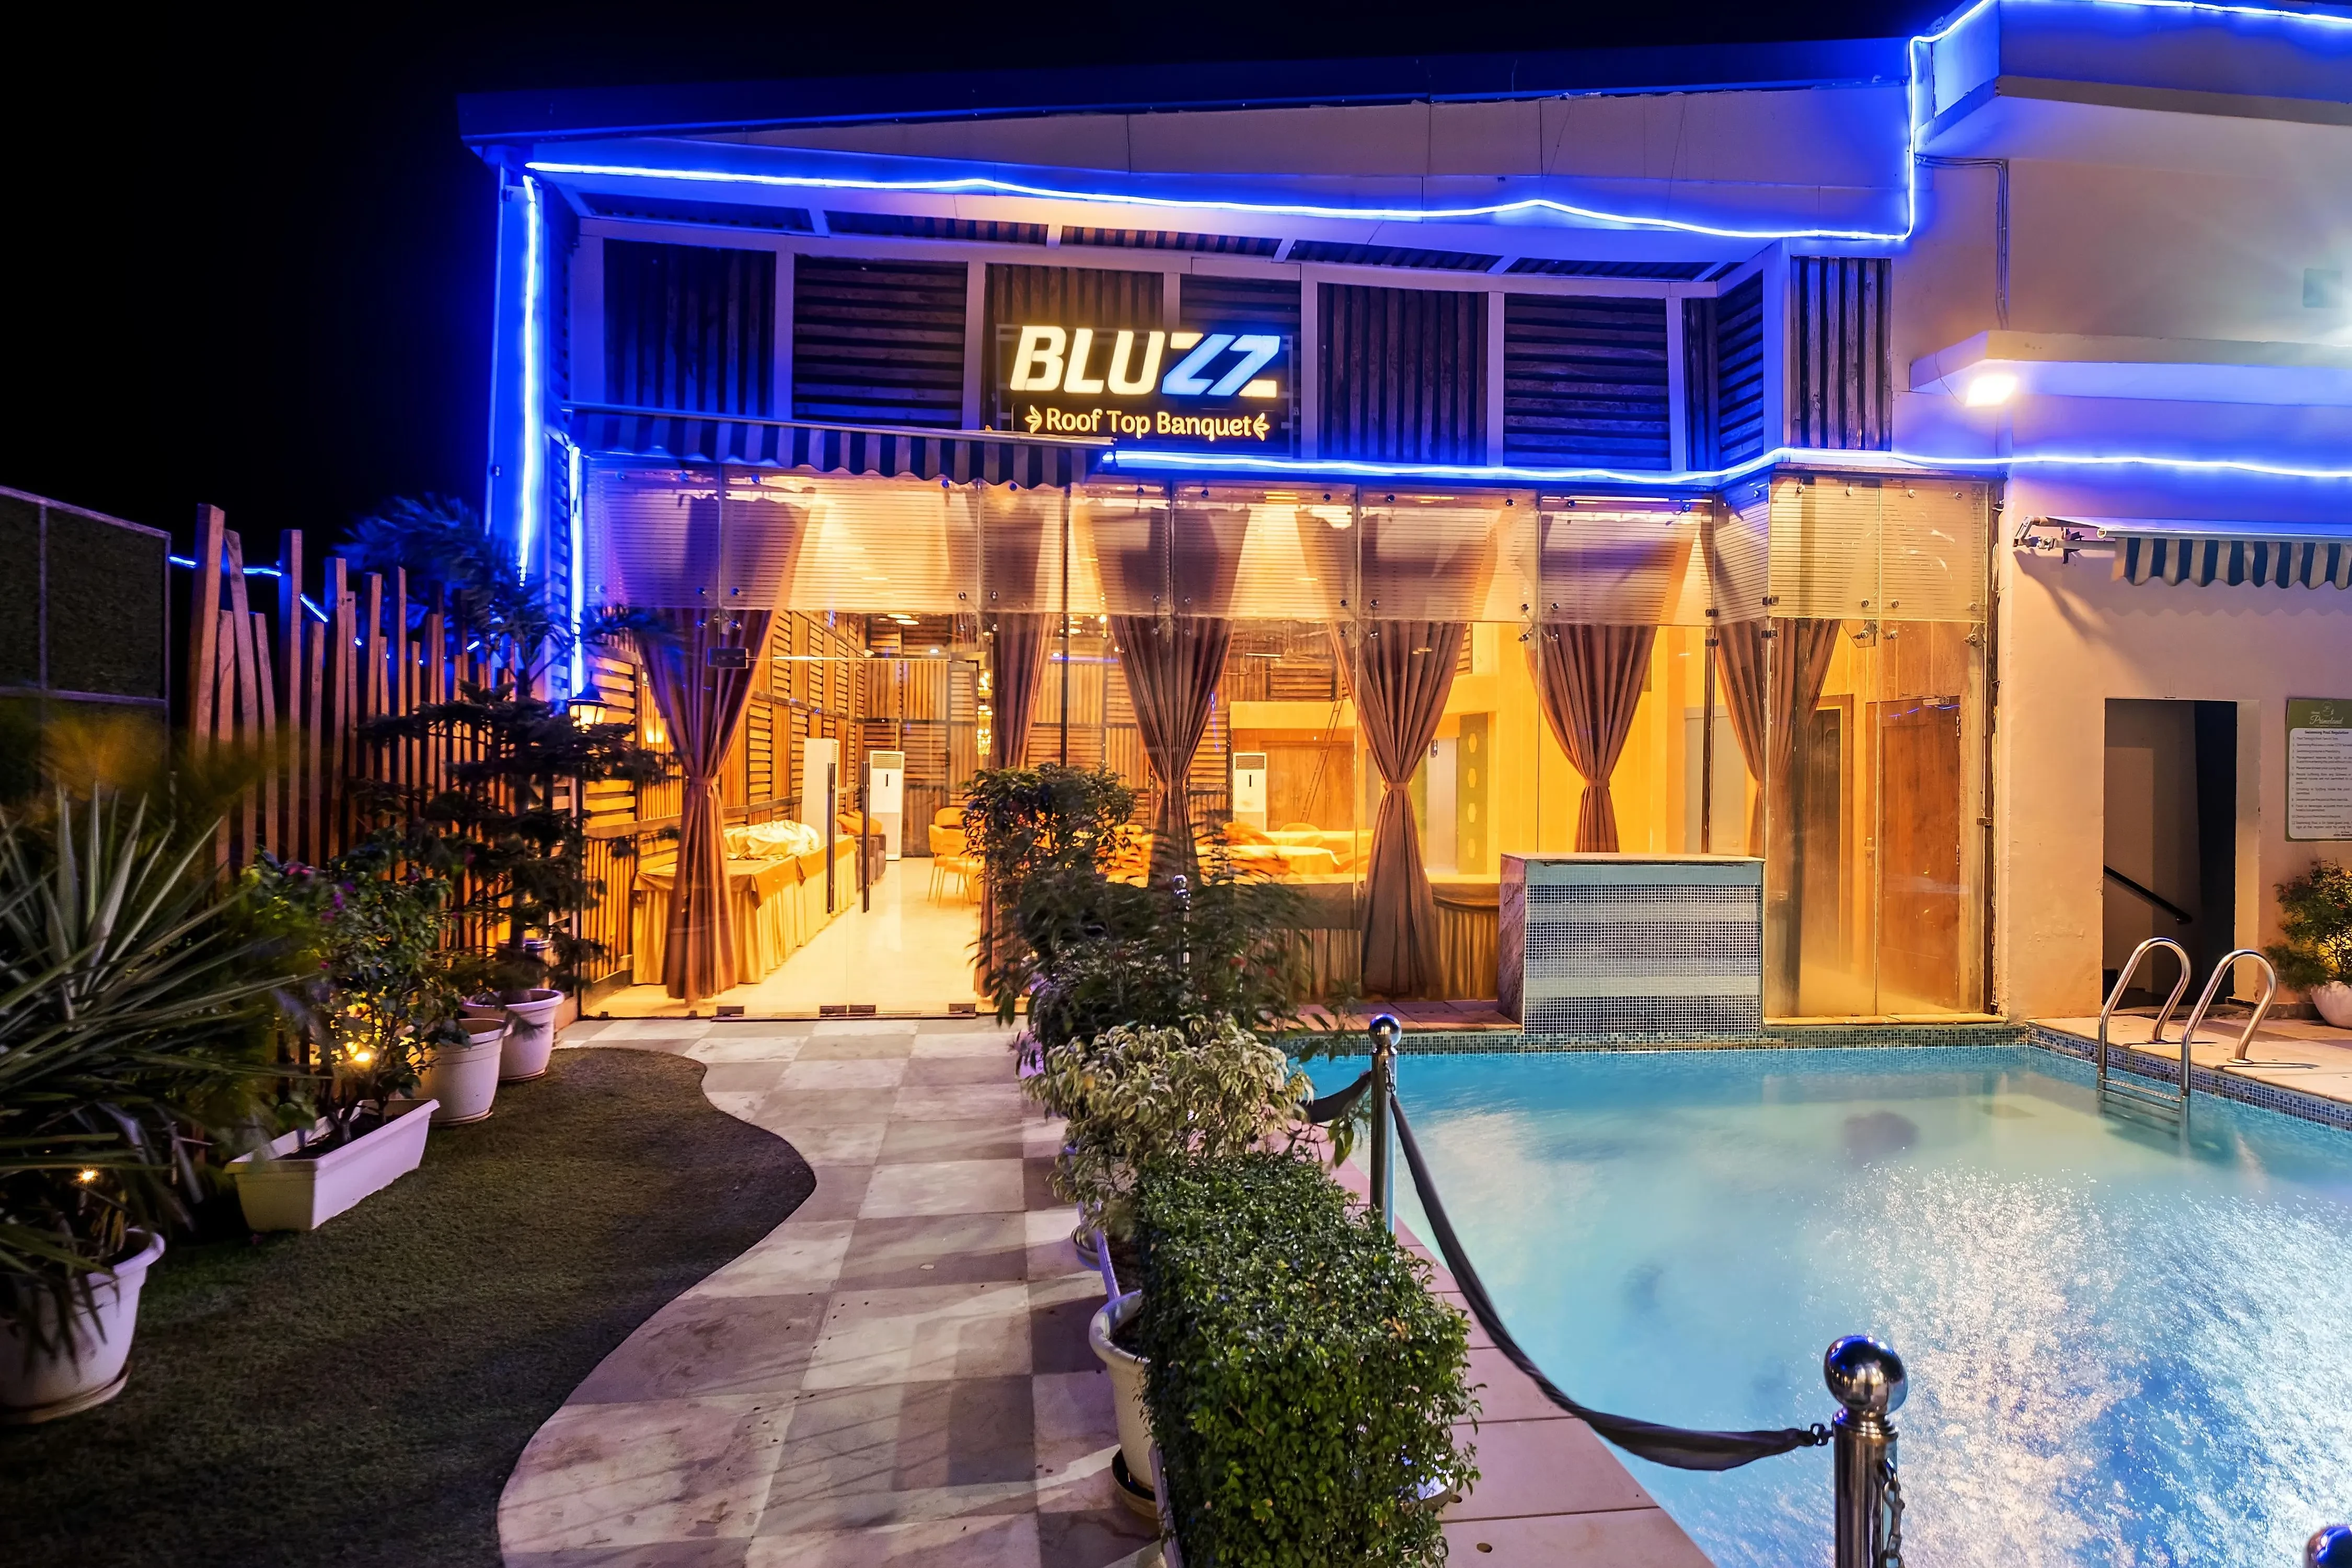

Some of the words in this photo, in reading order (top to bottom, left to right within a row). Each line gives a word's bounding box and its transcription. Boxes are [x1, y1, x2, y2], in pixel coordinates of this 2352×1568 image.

[1010, 325, 1281, 398] BLUZZ
[1046, 408, 1103, 432] Roof
[1106, 410, 1150, 440] Top
[1157, 411, 1252, 442] Banquet
